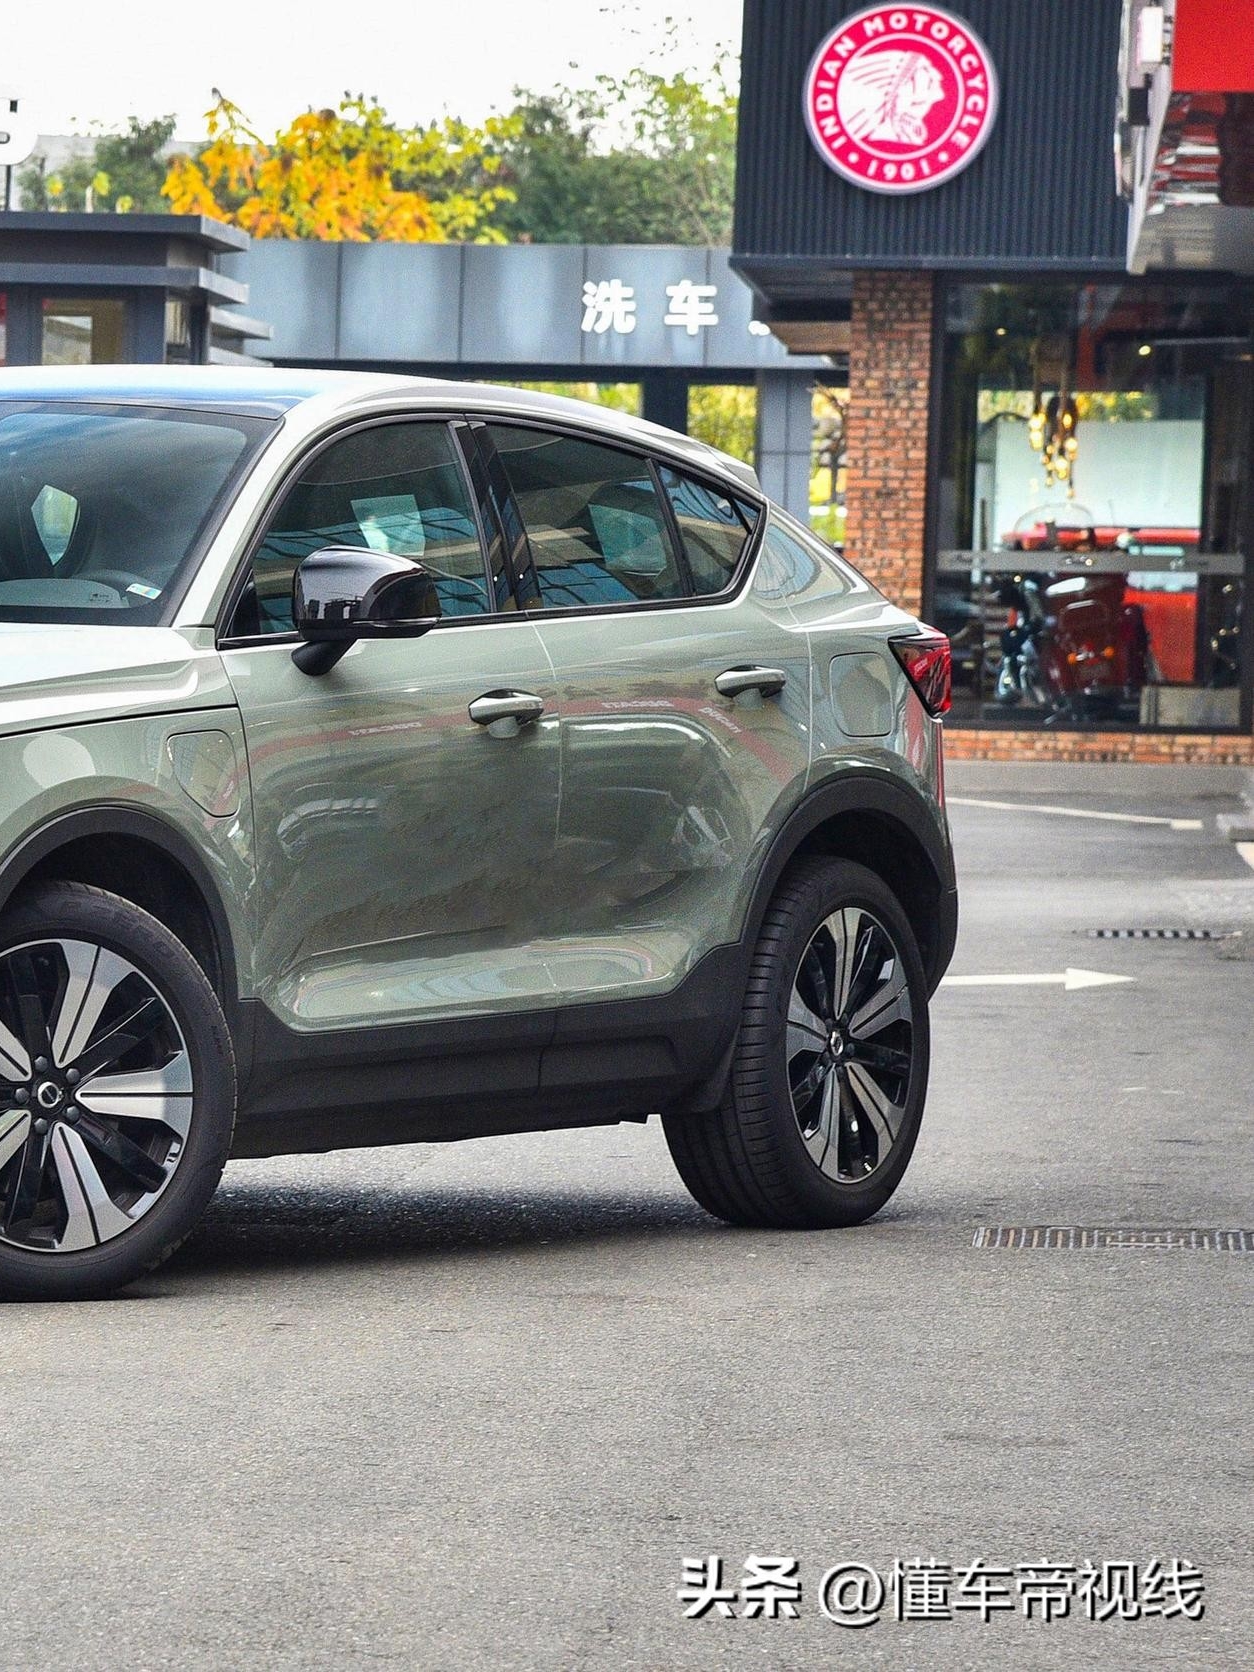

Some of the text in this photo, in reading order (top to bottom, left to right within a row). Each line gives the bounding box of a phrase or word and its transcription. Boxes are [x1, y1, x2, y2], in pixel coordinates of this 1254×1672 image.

[815, 12, 985, 150] INDIAN MOTORCYCLE
[866, 158, 931, 181] 1901
[581, 279, 771, 335] 洗车
